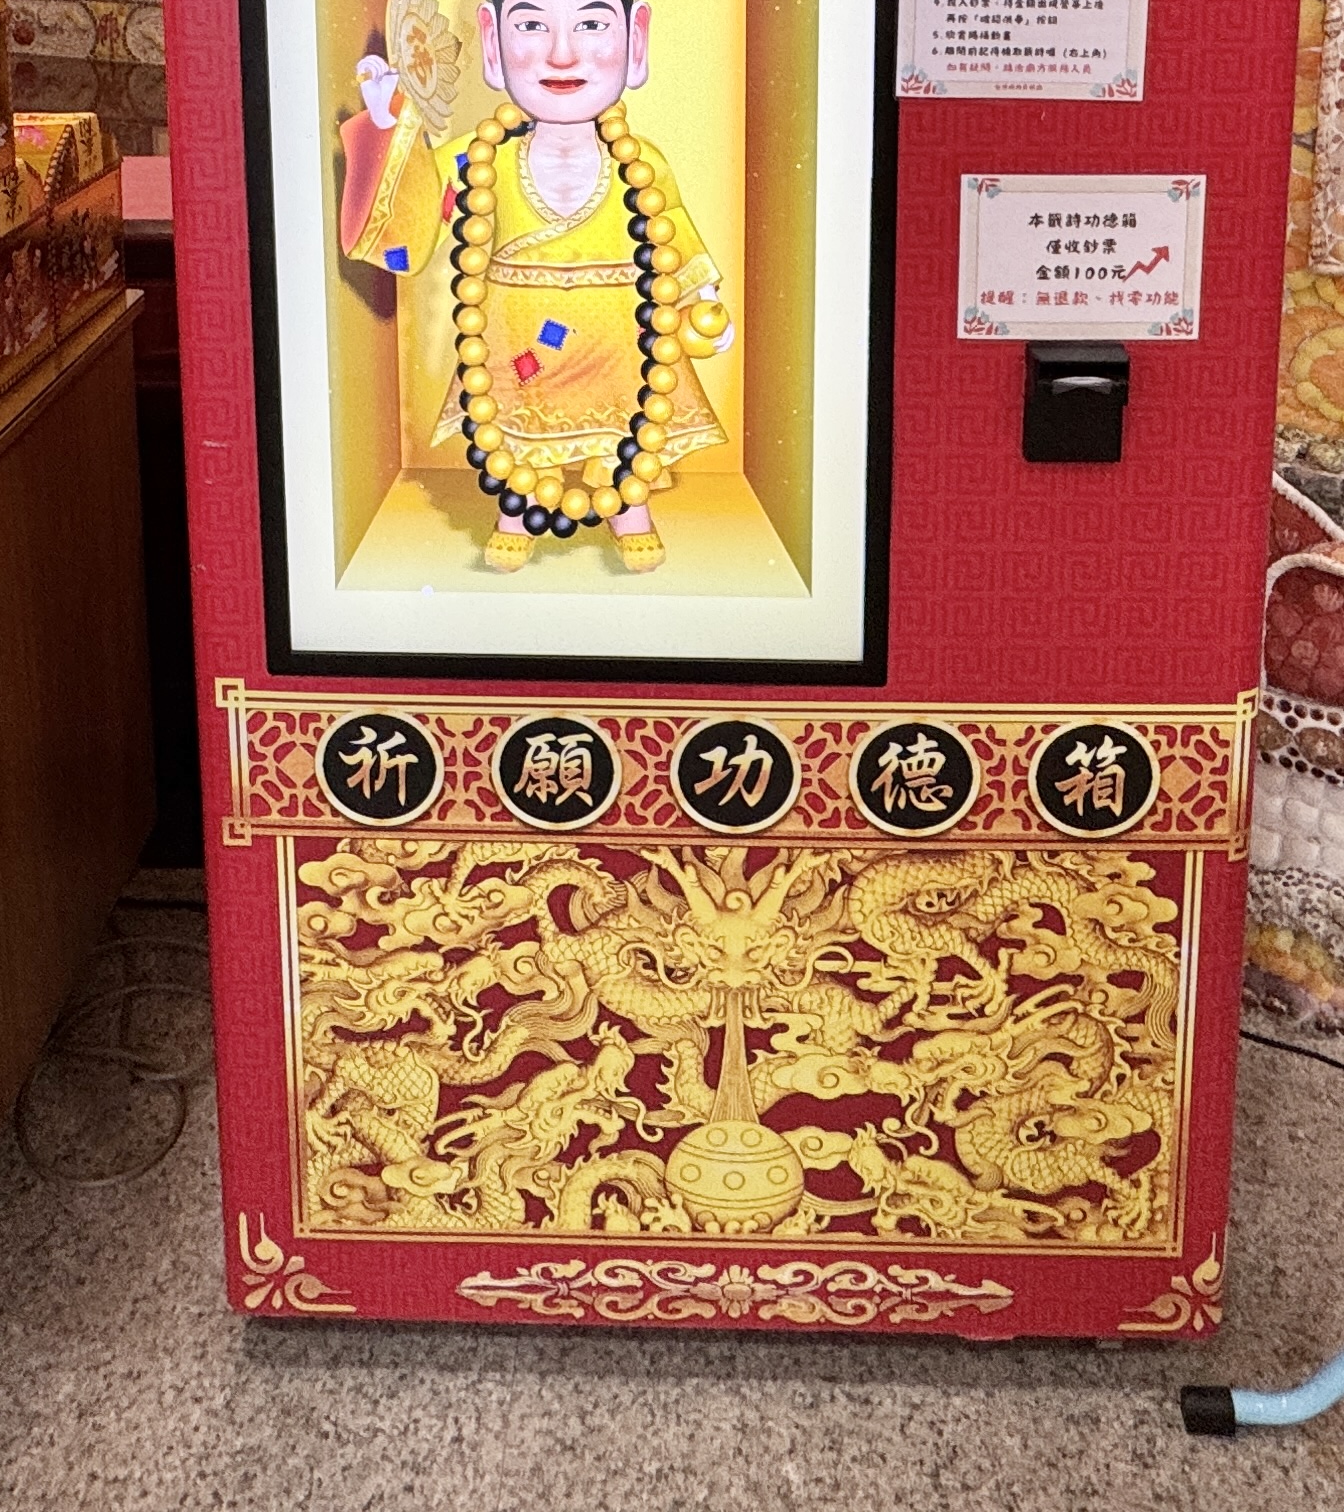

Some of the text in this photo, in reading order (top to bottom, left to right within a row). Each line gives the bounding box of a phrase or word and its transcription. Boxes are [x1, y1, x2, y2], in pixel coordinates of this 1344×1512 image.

[1045, 239, 1117, 255] 僅收鈔票
[1035, 265, 1126, 281] 金額100元
[341, 724, 1129, 816] 祈願功德箱
